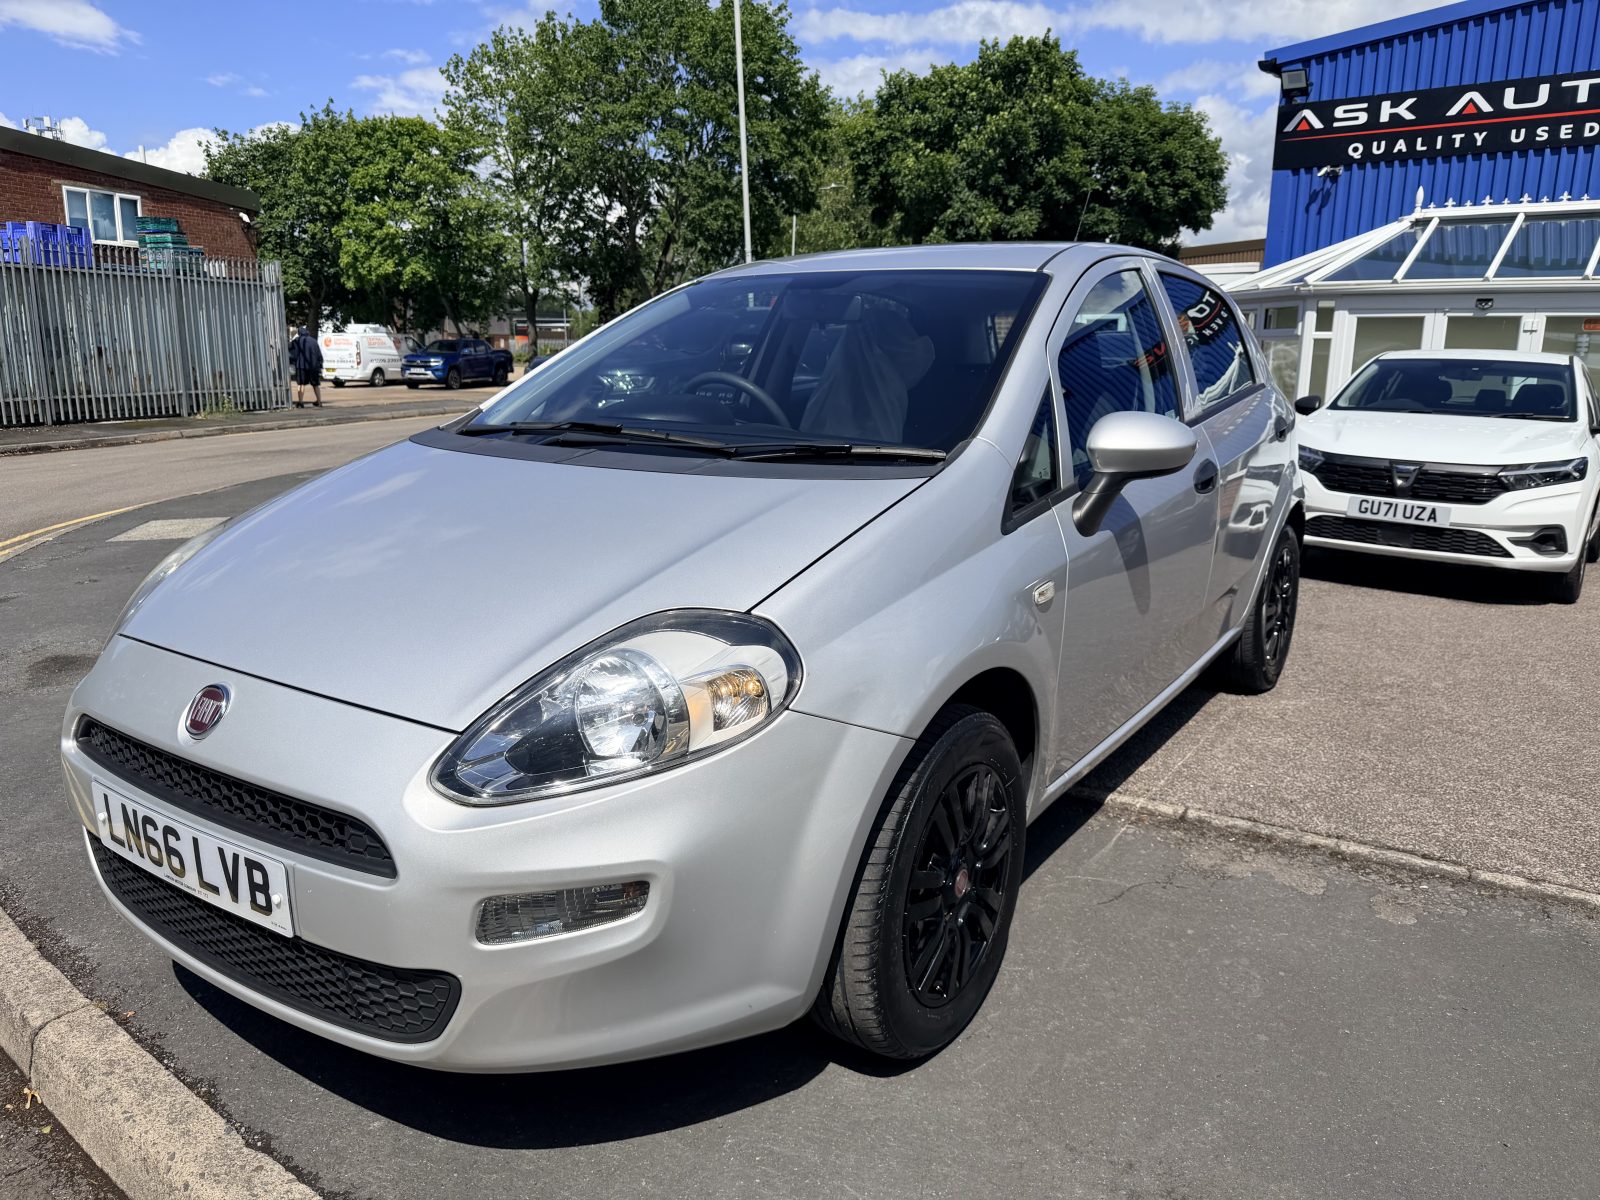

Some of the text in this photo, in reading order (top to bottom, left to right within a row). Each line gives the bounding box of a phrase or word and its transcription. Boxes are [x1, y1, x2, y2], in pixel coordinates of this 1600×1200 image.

[1283, 97, 1417, 132] ASK
[1348, 121, 1600, 159] QUALITY USED
[1358, 499, 1437, 523] GU71 UZA
[192, 696, 222, 724] FIAT
[103, 794, 273, 917] LN66 LVB
